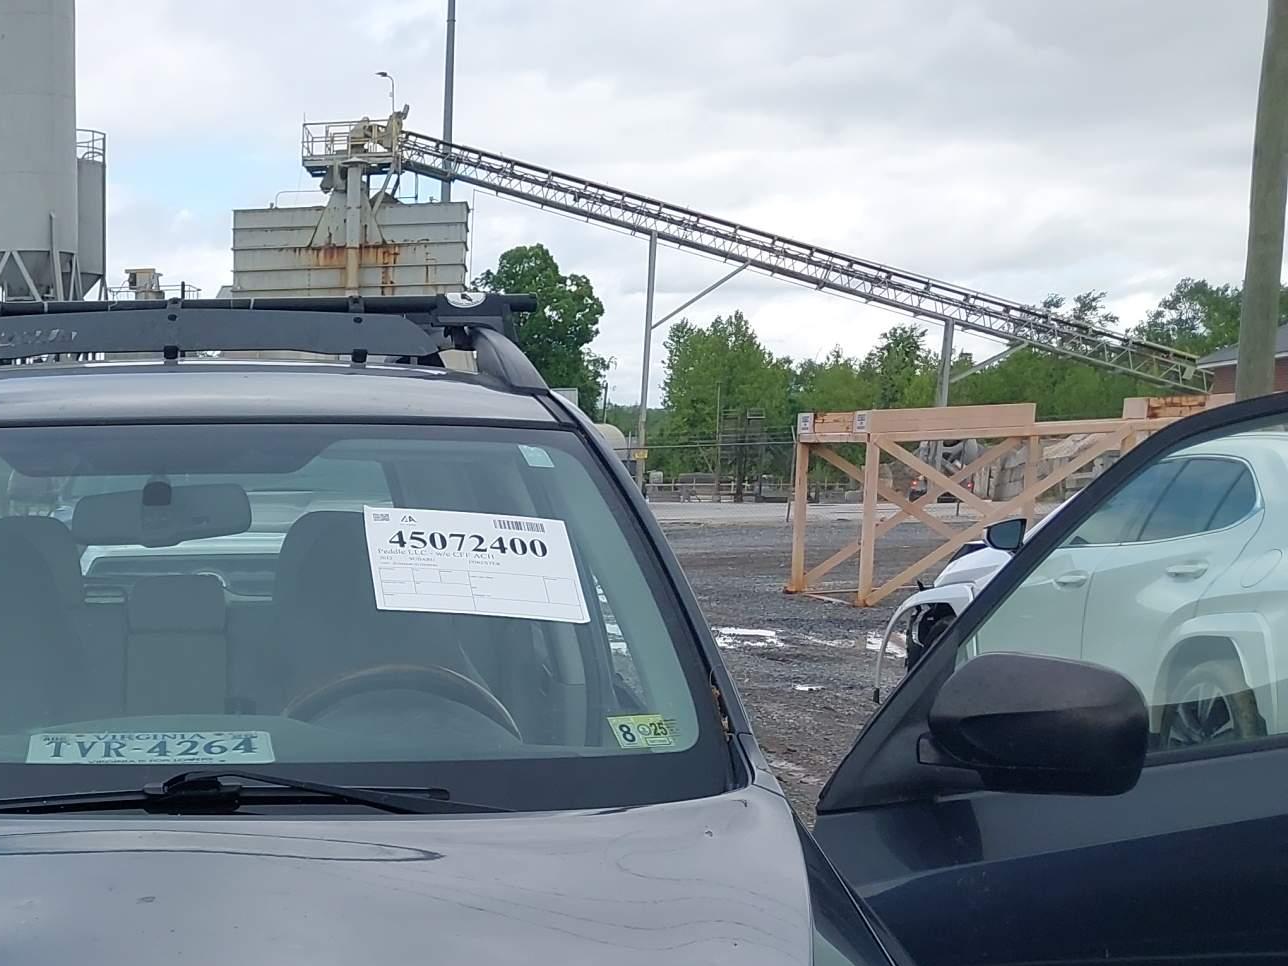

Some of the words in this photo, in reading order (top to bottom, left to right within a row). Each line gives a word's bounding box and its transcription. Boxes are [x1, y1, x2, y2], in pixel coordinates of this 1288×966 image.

[389, 530, 547, 558] 45072400
[95, 729, 205, 741] VIRGINIA
[618, 724, 636, 742] 8
[649, 722, 668, 736] 25
[45, 739, 258, 757] TVR-4264
